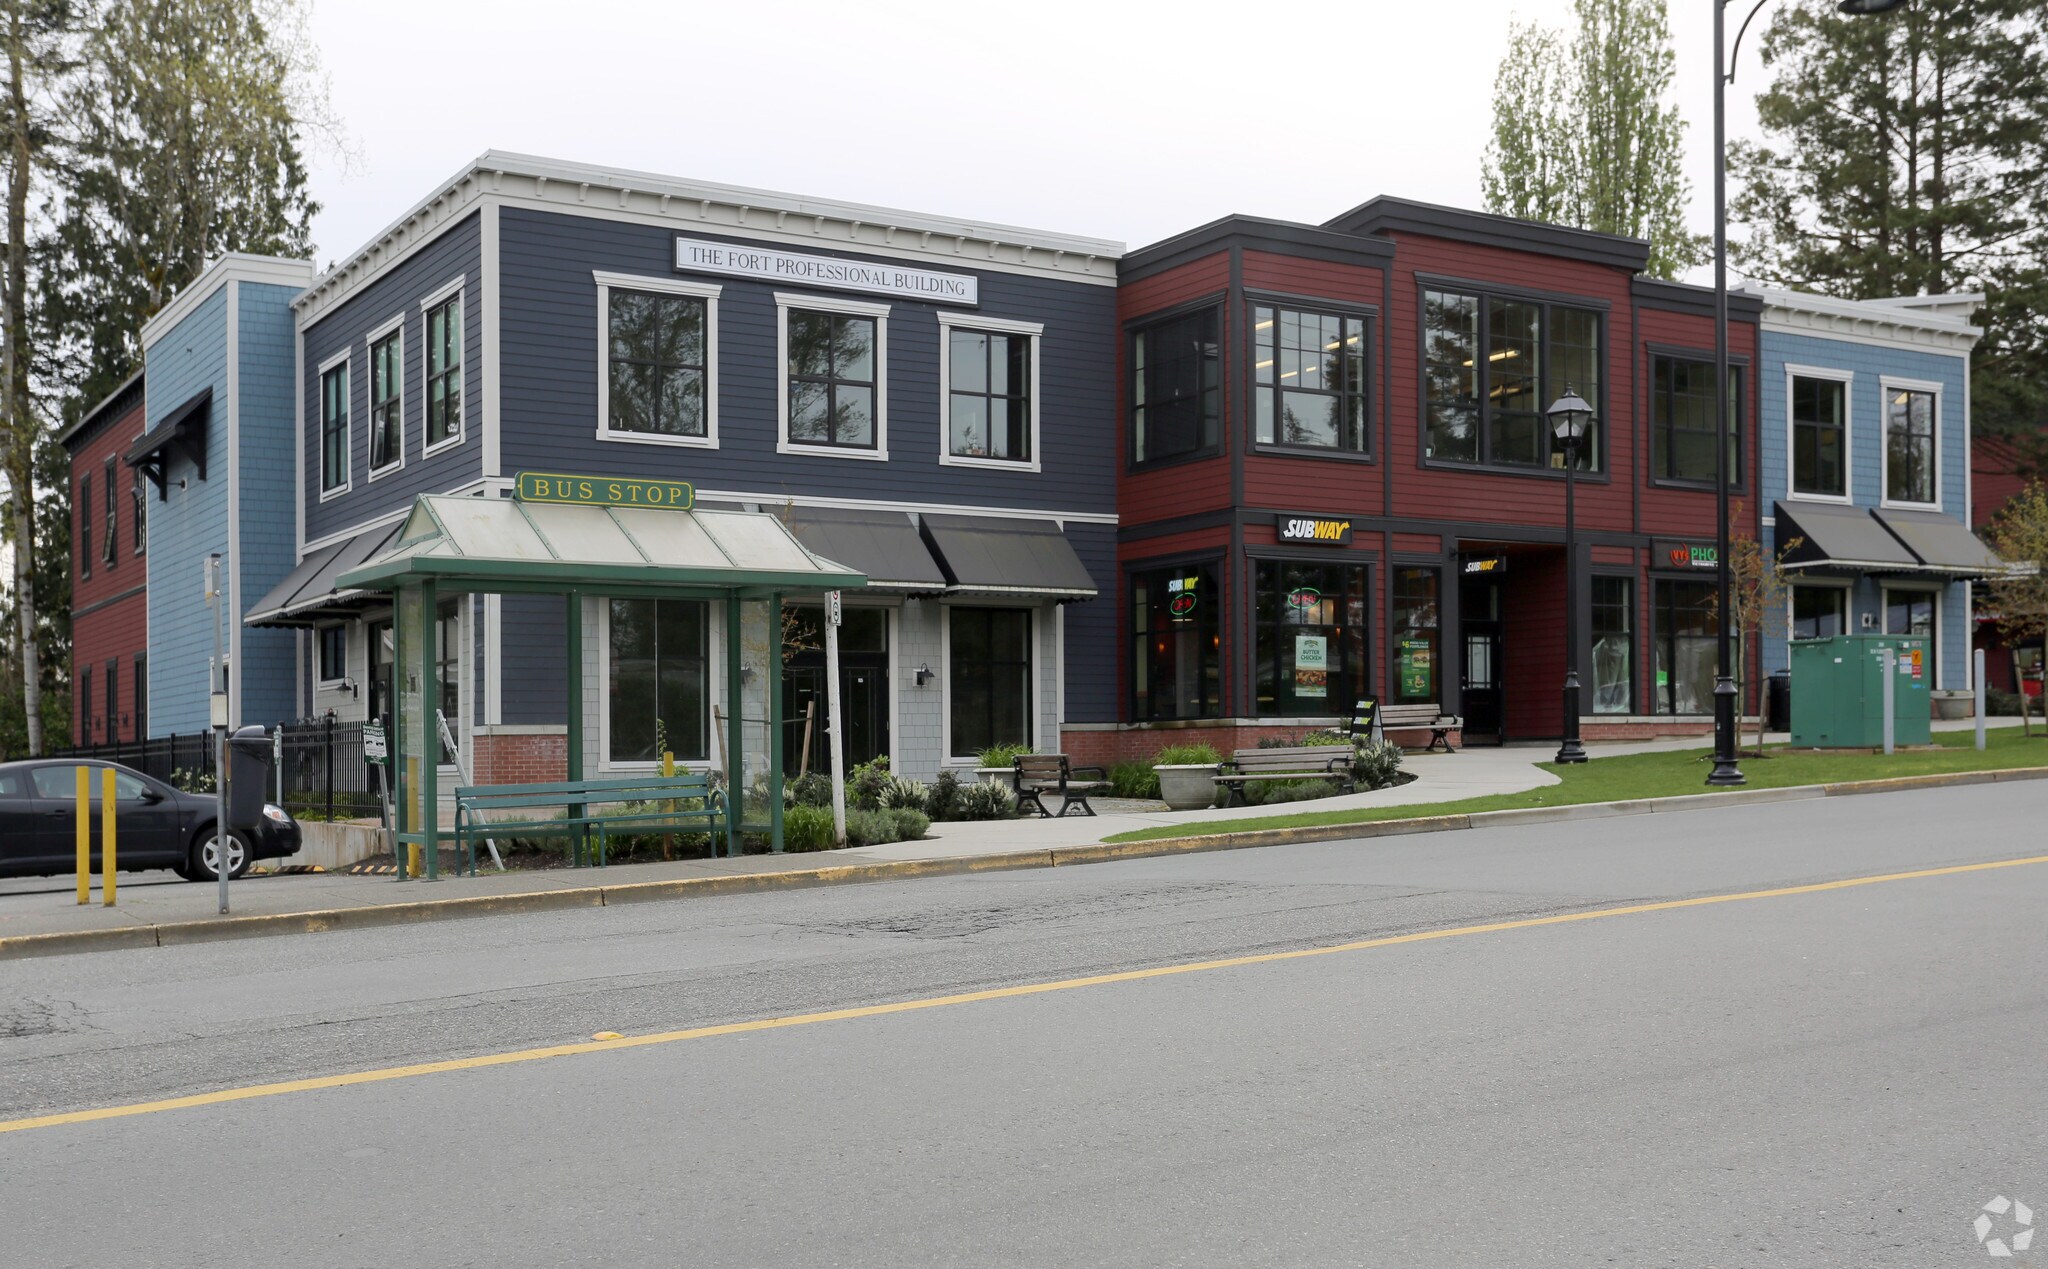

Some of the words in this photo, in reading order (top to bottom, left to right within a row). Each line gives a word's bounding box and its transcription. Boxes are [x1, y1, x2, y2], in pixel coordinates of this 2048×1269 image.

[689, 247, 723, 266] THE
[728, 251, 772, 271] FORT
[776, 258, 891, 287] PROFESSIONAL
[895, 273, 966, 296] BUILDING
[534, 479, 593, 500] BUS
[608, 483, 682, 504] STOP
[1283, 519, 1350, 540] SUBWAY
[1691, 547, 1717, 561] PHO
[1465, 559, 1498, 572] SUBWAY
